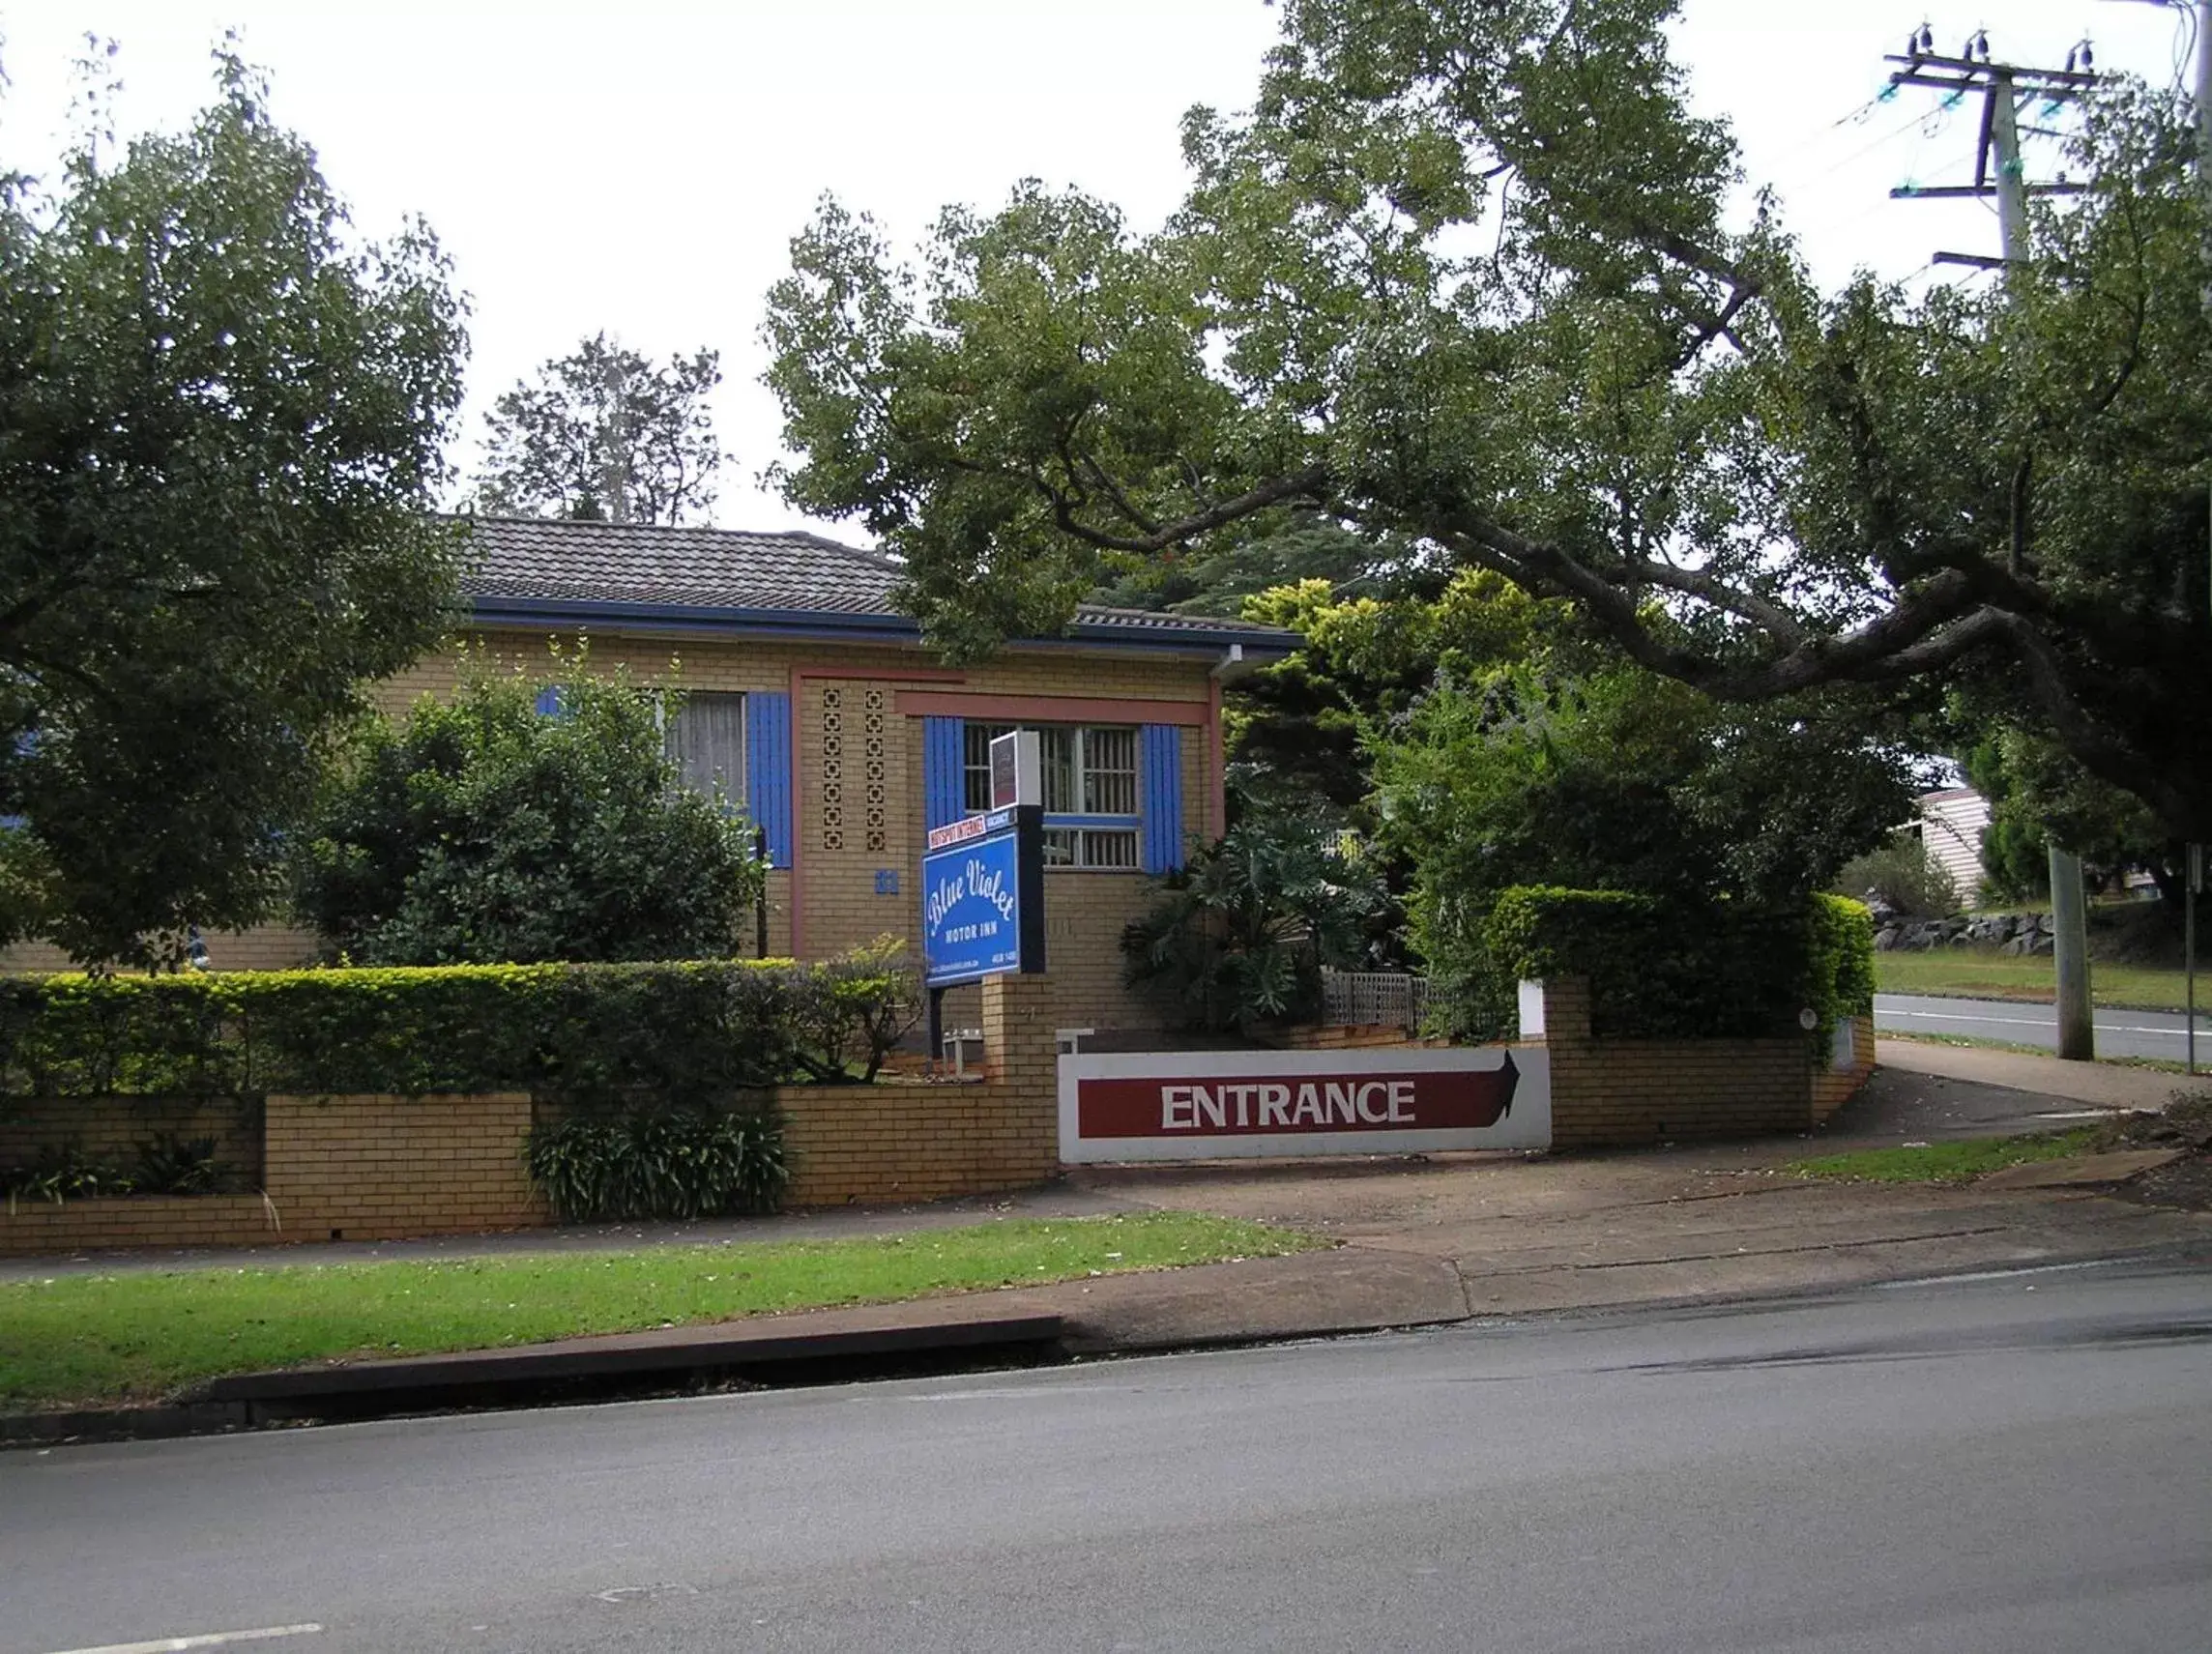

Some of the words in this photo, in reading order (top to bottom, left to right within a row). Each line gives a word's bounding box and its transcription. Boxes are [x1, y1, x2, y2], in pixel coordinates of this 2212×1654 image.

[928, 877, 964, 938] Blue
[966, 858, 1014, 921] Violet
[945, 923, 977, 943] MOTOR
[979, 919, 998, 938] INN
[1160, 1081, 1415, 1129] ENTRANCE
